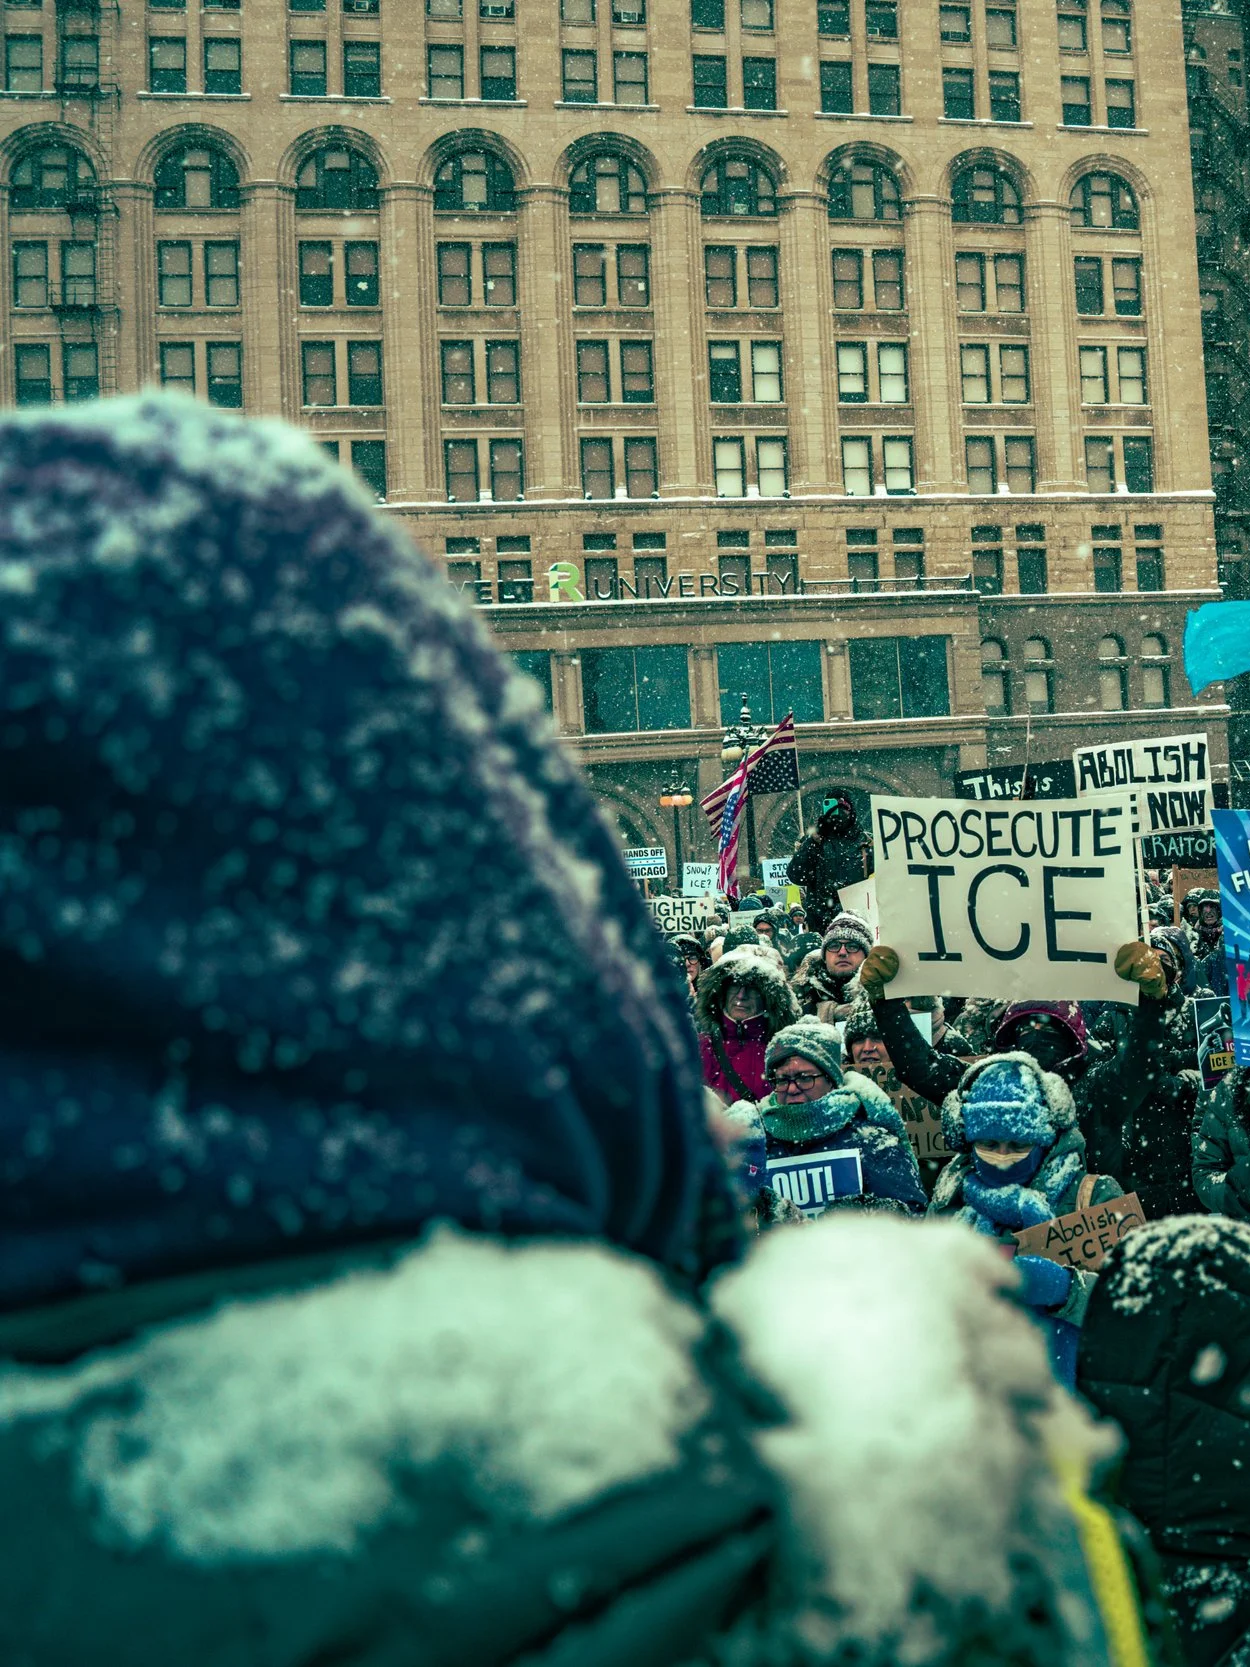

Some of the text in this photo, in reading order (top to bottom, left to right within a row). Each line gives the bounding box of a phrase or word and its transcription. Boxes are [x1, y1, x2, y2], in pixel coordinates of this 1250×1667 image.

[593, 572, 793, 600] UNIVERSITY
[1080, 742, 1206, 791] ABOLISH
[962, 775, 1053, 800] This is
[1147, 790, 1206, 830] NOW
[877, 808, 1123, 860] PROSECUTE
[1141, 836, 1216, 858] TRAITOR
[624, 849, 664, 858] HANDS OFF
[686, 865, 711, 875] SNOW?
[772, 863, 788, 871] STO
[690, 879, 711, 888] ICE?
[653, 916, 706, 931] SCISM
[908, 864, 1107, 963] ICE
[1212, 1057, 1228, 1067] ICE
[772, 1165, 835, 1206] OUT!
[1046, 1208, 1117, 1249] Abolish
[1059, 1232, 1114, 1266] ICE
